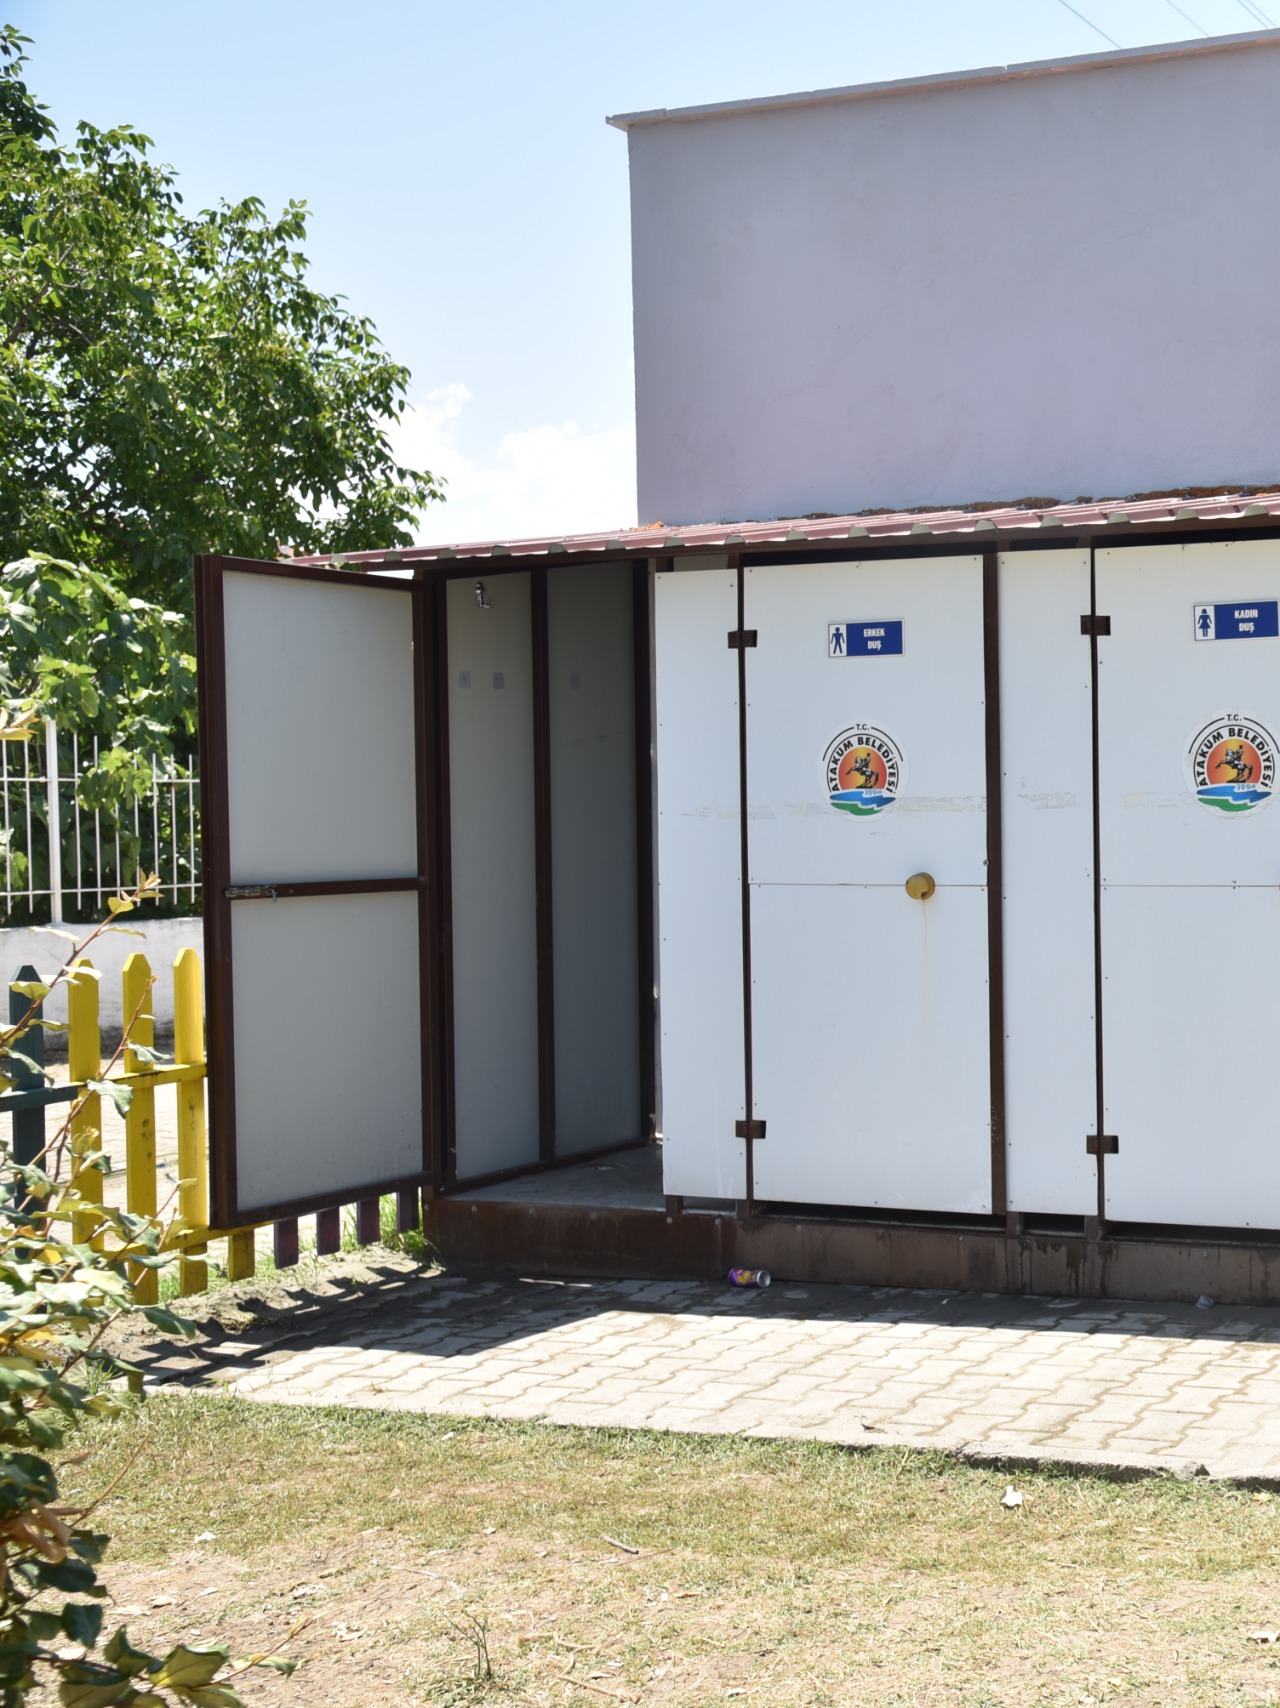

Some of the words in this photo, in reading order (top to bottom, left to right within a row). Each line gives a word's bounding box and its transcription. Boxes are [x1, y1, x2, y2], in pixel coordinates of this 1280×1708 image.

[1234, 608, 1258, 619] KADIN
[863, 628, 885, 637] ERKEK
[1238, 622, 1255, 633] DUŞ
[867, 640, 881, 651] DUŞ
[856, 723, 869, 731] T.C.
[1196, 731, 1224, 786] ATAKUM
[1228, 727, 1272, 788] BELEDİYESİ
[829, 740, 853, 792] ATAKUM
[857, 737, 896, 794] BELEDİYESİ
